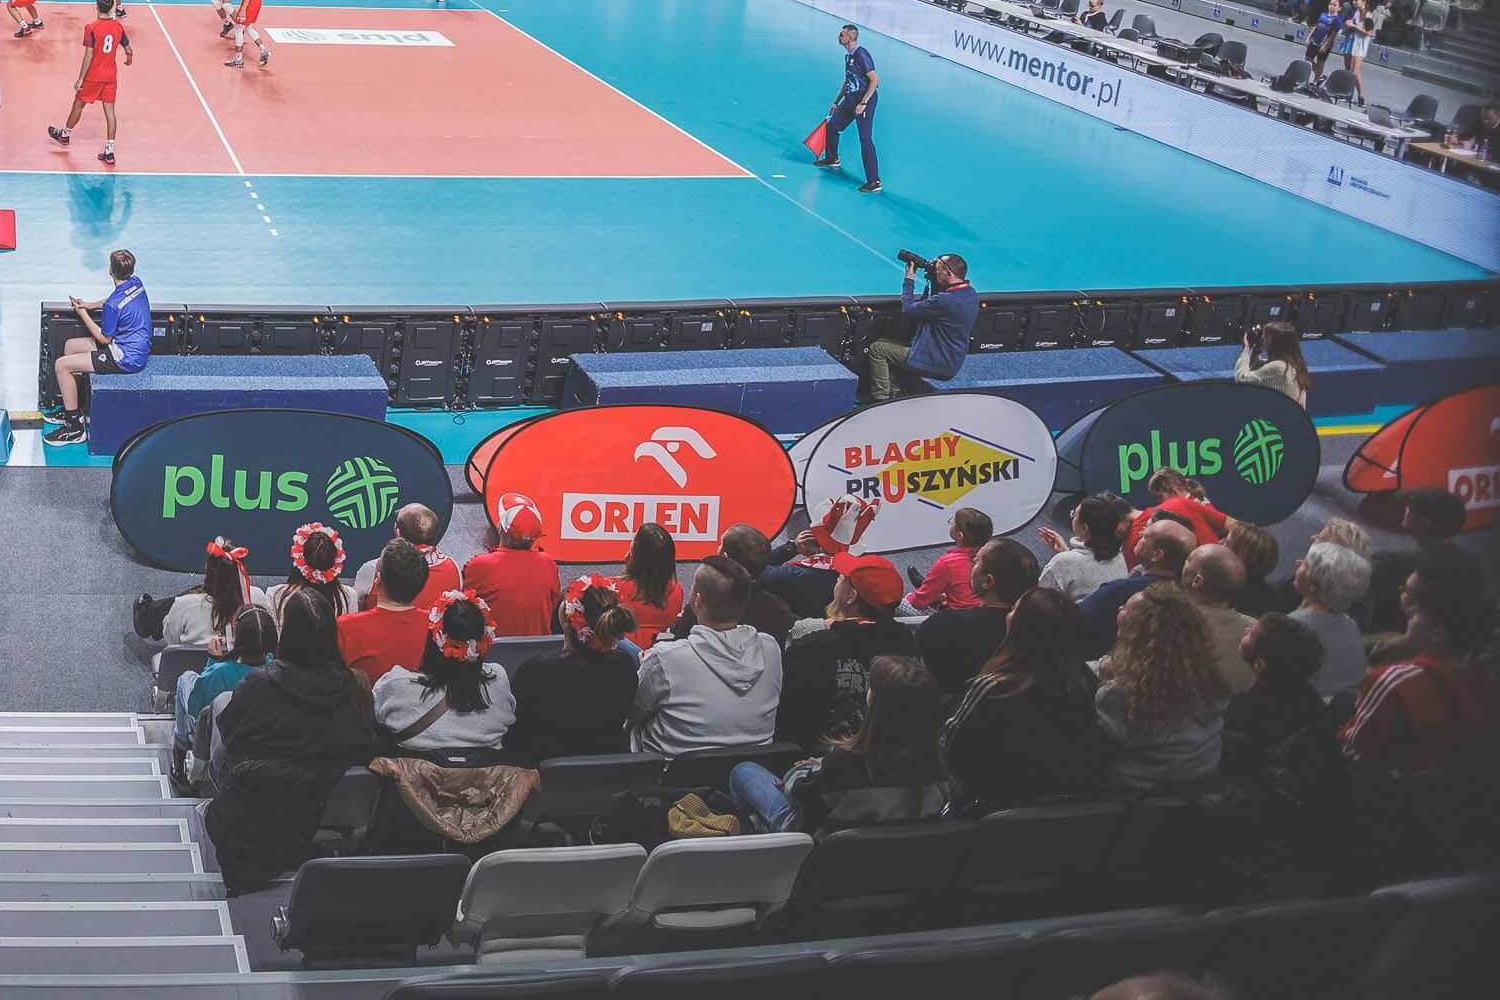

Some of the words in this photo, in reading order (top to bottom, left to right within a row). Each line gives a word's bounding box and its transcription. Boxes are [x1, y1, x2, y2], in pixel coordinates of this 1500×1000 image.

[102, 34, 114, 54] 8
[954, 29, 1122, 107] www.mentor.pl
[844, 435, 962, 469] BLACHY
[1118, 429, 1223, 494] plus
[163, 454, 309, 518] plus
[846, 458, 1020, 503] PRUSZYŃSKI
